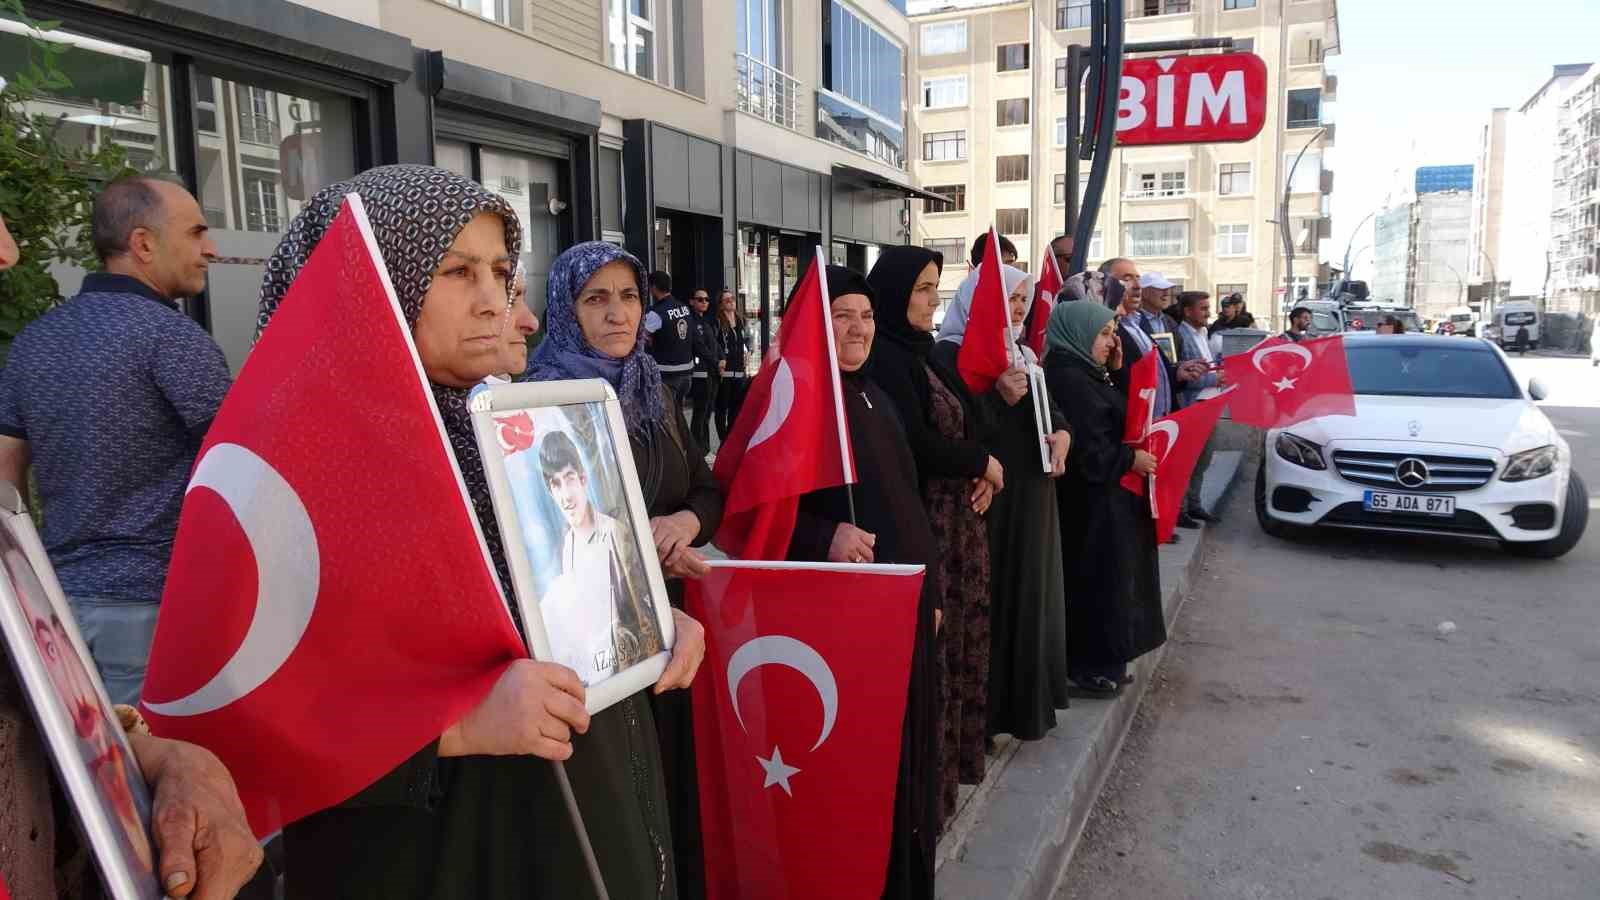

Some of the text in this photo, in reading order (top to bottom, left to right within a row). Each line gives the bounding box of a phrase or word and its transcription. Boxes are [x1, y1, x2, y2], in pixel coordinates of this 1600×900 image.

[1372, 494, 1450, 513] 65 ADA 871
